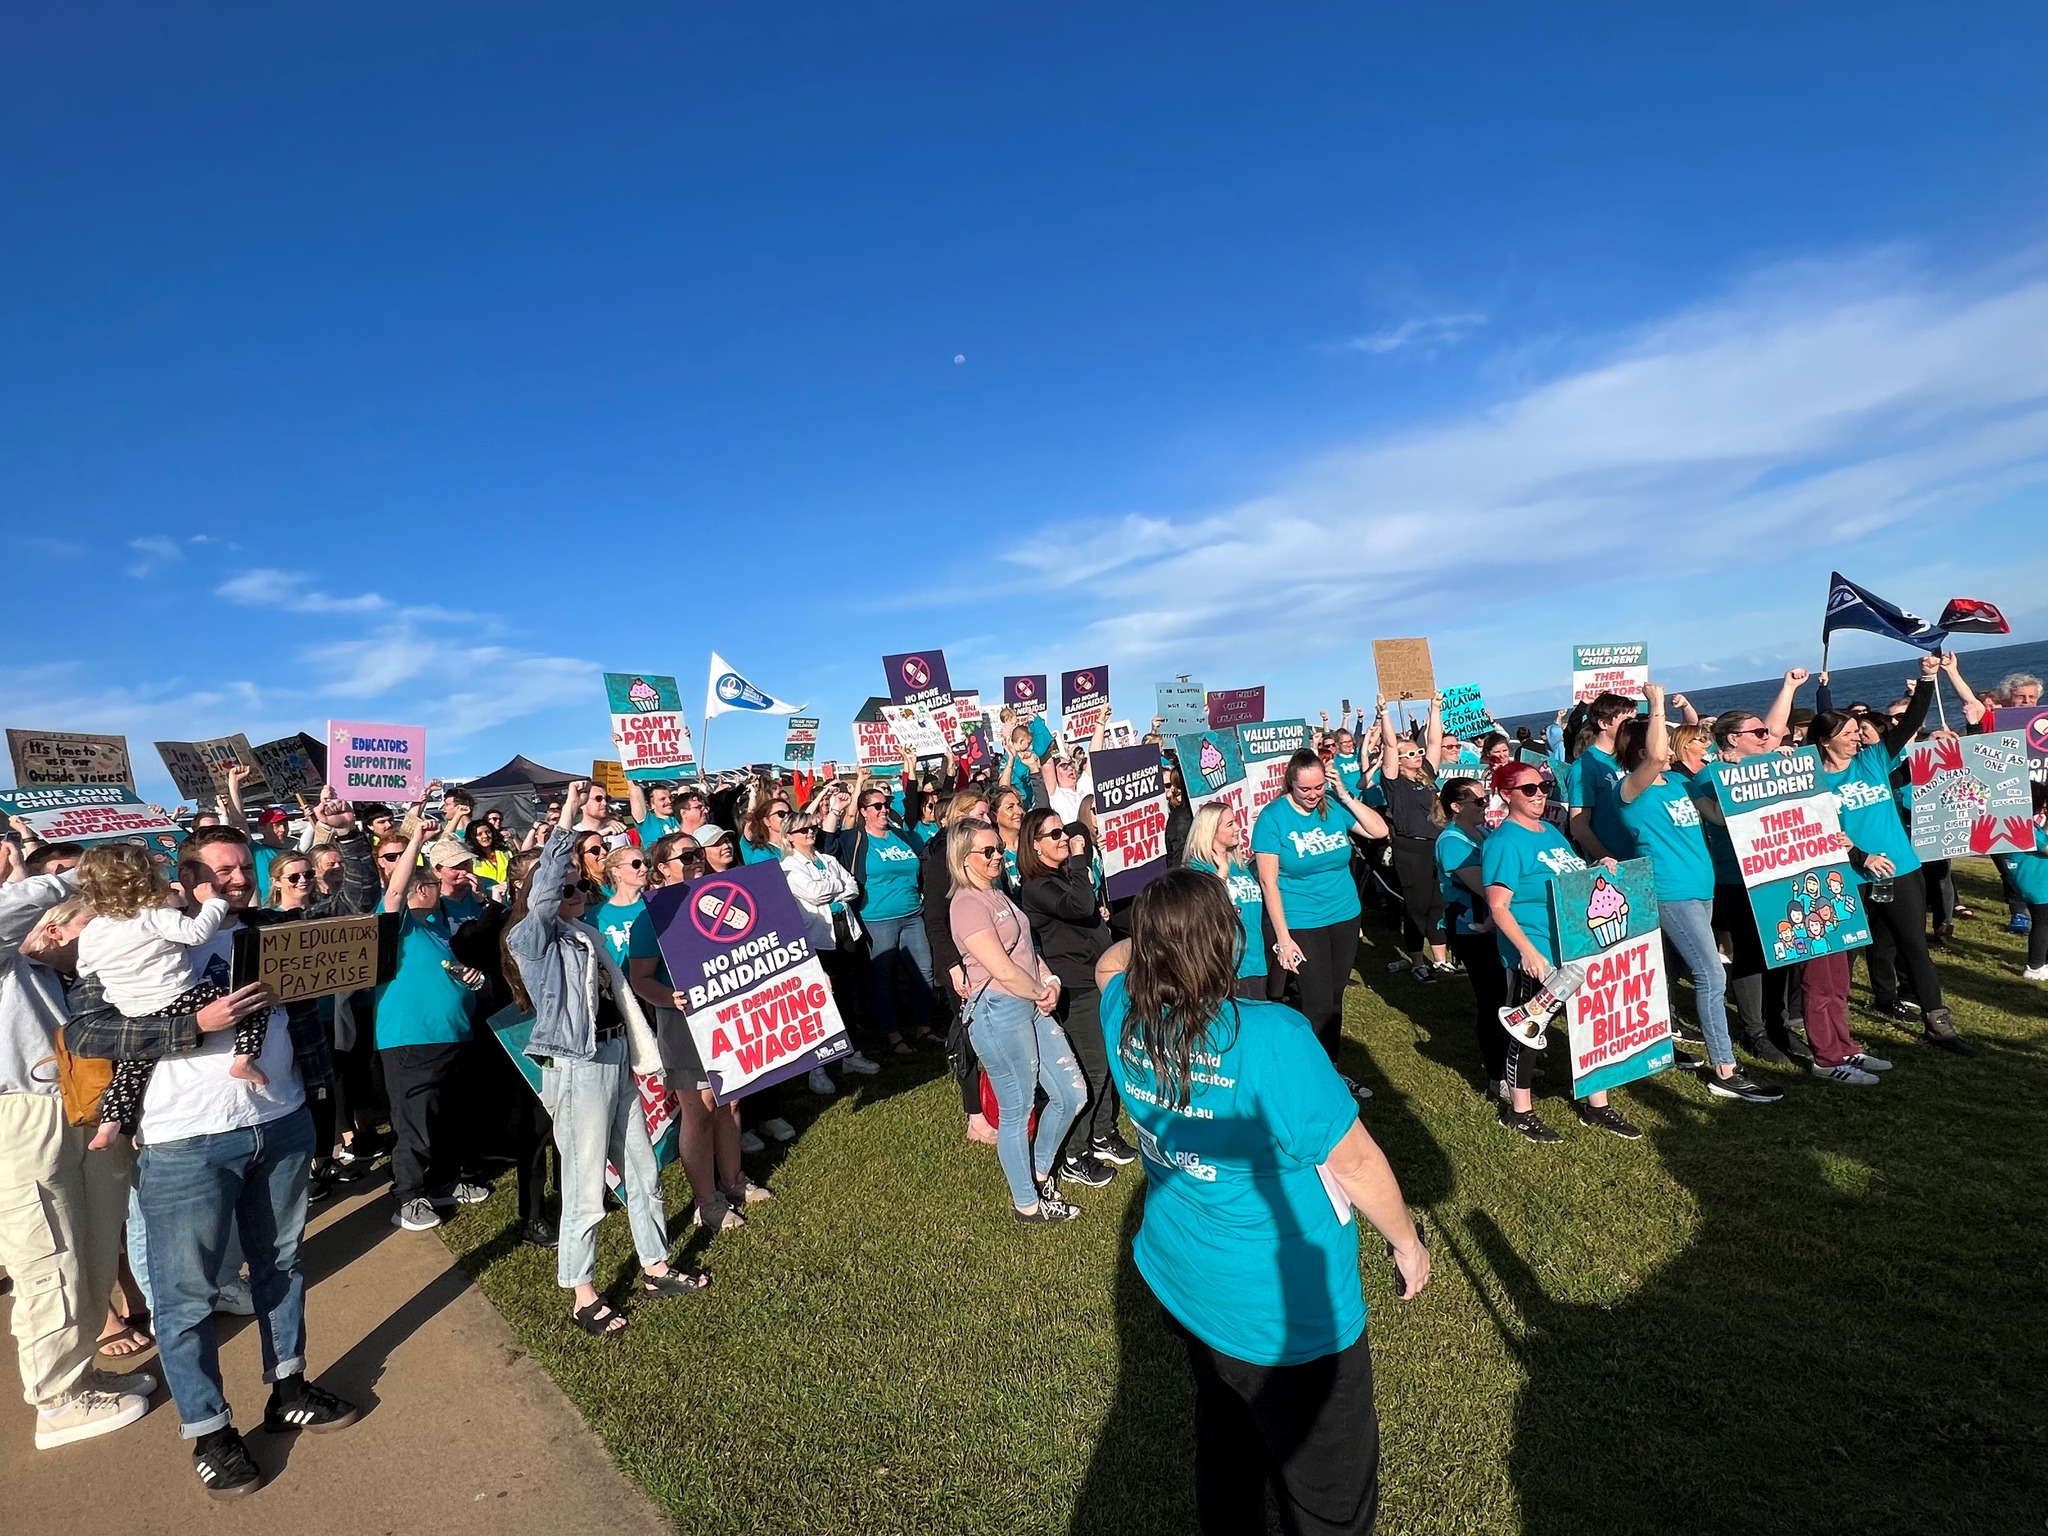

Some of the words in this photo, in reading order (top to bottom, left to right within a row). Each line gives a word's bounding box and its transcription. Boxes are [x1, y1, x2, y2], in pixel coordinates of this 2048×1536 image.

[1578, 647, 1611, 657] VALUE
[1613, 646, 1642, 655] YOUR
[1581, 655, 1639, 665] CHILDREN?
[1594, 671, 1624, 681] THEN
[905, 695, 916, 704] NO
[918, 687, 939, 699] MORE
[1082, 692, 1099, 700] MORE
[1065, 695, 1107, 713] BANDAIDS!
[621, 718, 626, 732] I
[630, 716, 676, 730] CAN'T
[859, 724, 862, 734] I
[1067, 721, 1073, 730] A
[624, 730, 654, 745] PAY
[658, 729, 681, 742] MY
[860, 734, 887, 746] PAY
[1243, 728, 1275, 741] VALUE
[1277, 726, 1303, 738] YOUR
[30, 742, 50, 755] It's
[83, 744, 96, 756] to
[352, 738, 408, 754] EDUCATORS
[637, 742, 680, 758] BILLS
[869, 746, 900, 756] BILLS
[1250, 738, 1302, 754] CHILDREN?
[2002, 738, 2018, 749] WE
[344, 755, 412, 770] SUPPORTING
[627, 758, 648, 766] WITH
[650, 754, 692, 764] CUPCAKES!
[1974, 745, 2001, 759] WALK
[2008, 755, 2024, 765] AS
[1439, 769, 1475, 778] VALUE
[1718, 762, 1770, 786] VALUE
[1771, 756, 1815, 777] YOUR
[1985, 760, 2003, 772] ONE
[348, 773, 407, 788] EDUCATORS
[1097, 779, 1114, 792] GIVE
[1116, 776, 1125, 786] US
[1125, 774, 1131, 783] A
[1132, 765, 1158, 780] REASON
[1914, 781, 1937, 800] HAND
[1946, 768, 1970, 779] HAND
[0, 790, 63, 802] VALUE
[70, 788, 122, 797] YOUR
[1103, 788, 1122, 808] TO
[1125, 775, 1159, 801] STAY.
[1731, 774, 1815, 803] CHILDREN?
[1838, 780, 1869, 795] BIG
[1843, 784, 1890, 807] STEPS
[16, 796, 124, 809] CHILDREN?
[1950, 802, 1973, 810] MAKE
[51, 816, 101, 828] VALUE
[102, 813, 144, 824] THEIR
[60, 808, 118, 819] THEN
[1105, 816, 1121, 831] IT'S
[1123, 808, 1142, 822] TIME
[1144, 802, 1160, 816] FOR
[1760, 806, 1805, 834] THEN
[40, 818, 172, 838] EDUCATORS!
[1946, 820, 1970, 828] RIGHT
[1106, 813, 1166, 852] BETTER
[1302, 828, 1326, 841] BIG
[1751, 830, 1790, 852] VALUE
[1791, 822, 1823, 841] THEIR
[1943, 834, 1953, 843] DO
[1306, 831, 1346, 853] STEPS
[1124, 835, 1159, 867] PAY!
[1550, 847, 1571, 861] BIG
[1944, 846, 1968, 855] RIGHT
[1232, 876, 1253, 887] BIG
[1240, 887, 1262, 899] STEP
[263, 932, 292, 952] MY
[300, 925, 378, 949] EDUCATORS
[264, 950, 350, 974] DESERVE
[358, 946, 368, 960] A
[702, 955, 729, 978] NO
[731, 931, 780, 965] MORE
[688, 937, 810, 1009] BANDAIDS!
[1586, 943, 1649, 990] CAN'T
[716, 1004, 740, 1024] WE
[742, 976, 802, 1013] DEMAND
[1578, 983, 1618, 1025] PAY
[1623, 968, 1655, 1006] MY
[712, 1028, 733, 1059] A
[735, 984, 826, 1045] LIVING
[1593, 1000, 1650, 1047] BILLS
[735, 1011, 825, 1074] WAGE!
[1579, 1045, 1607, 1070] WITH
[1609, 1019, 1668, 1056] CUPCAKES!
[1176, 1152, 1200, 1166] BIG
